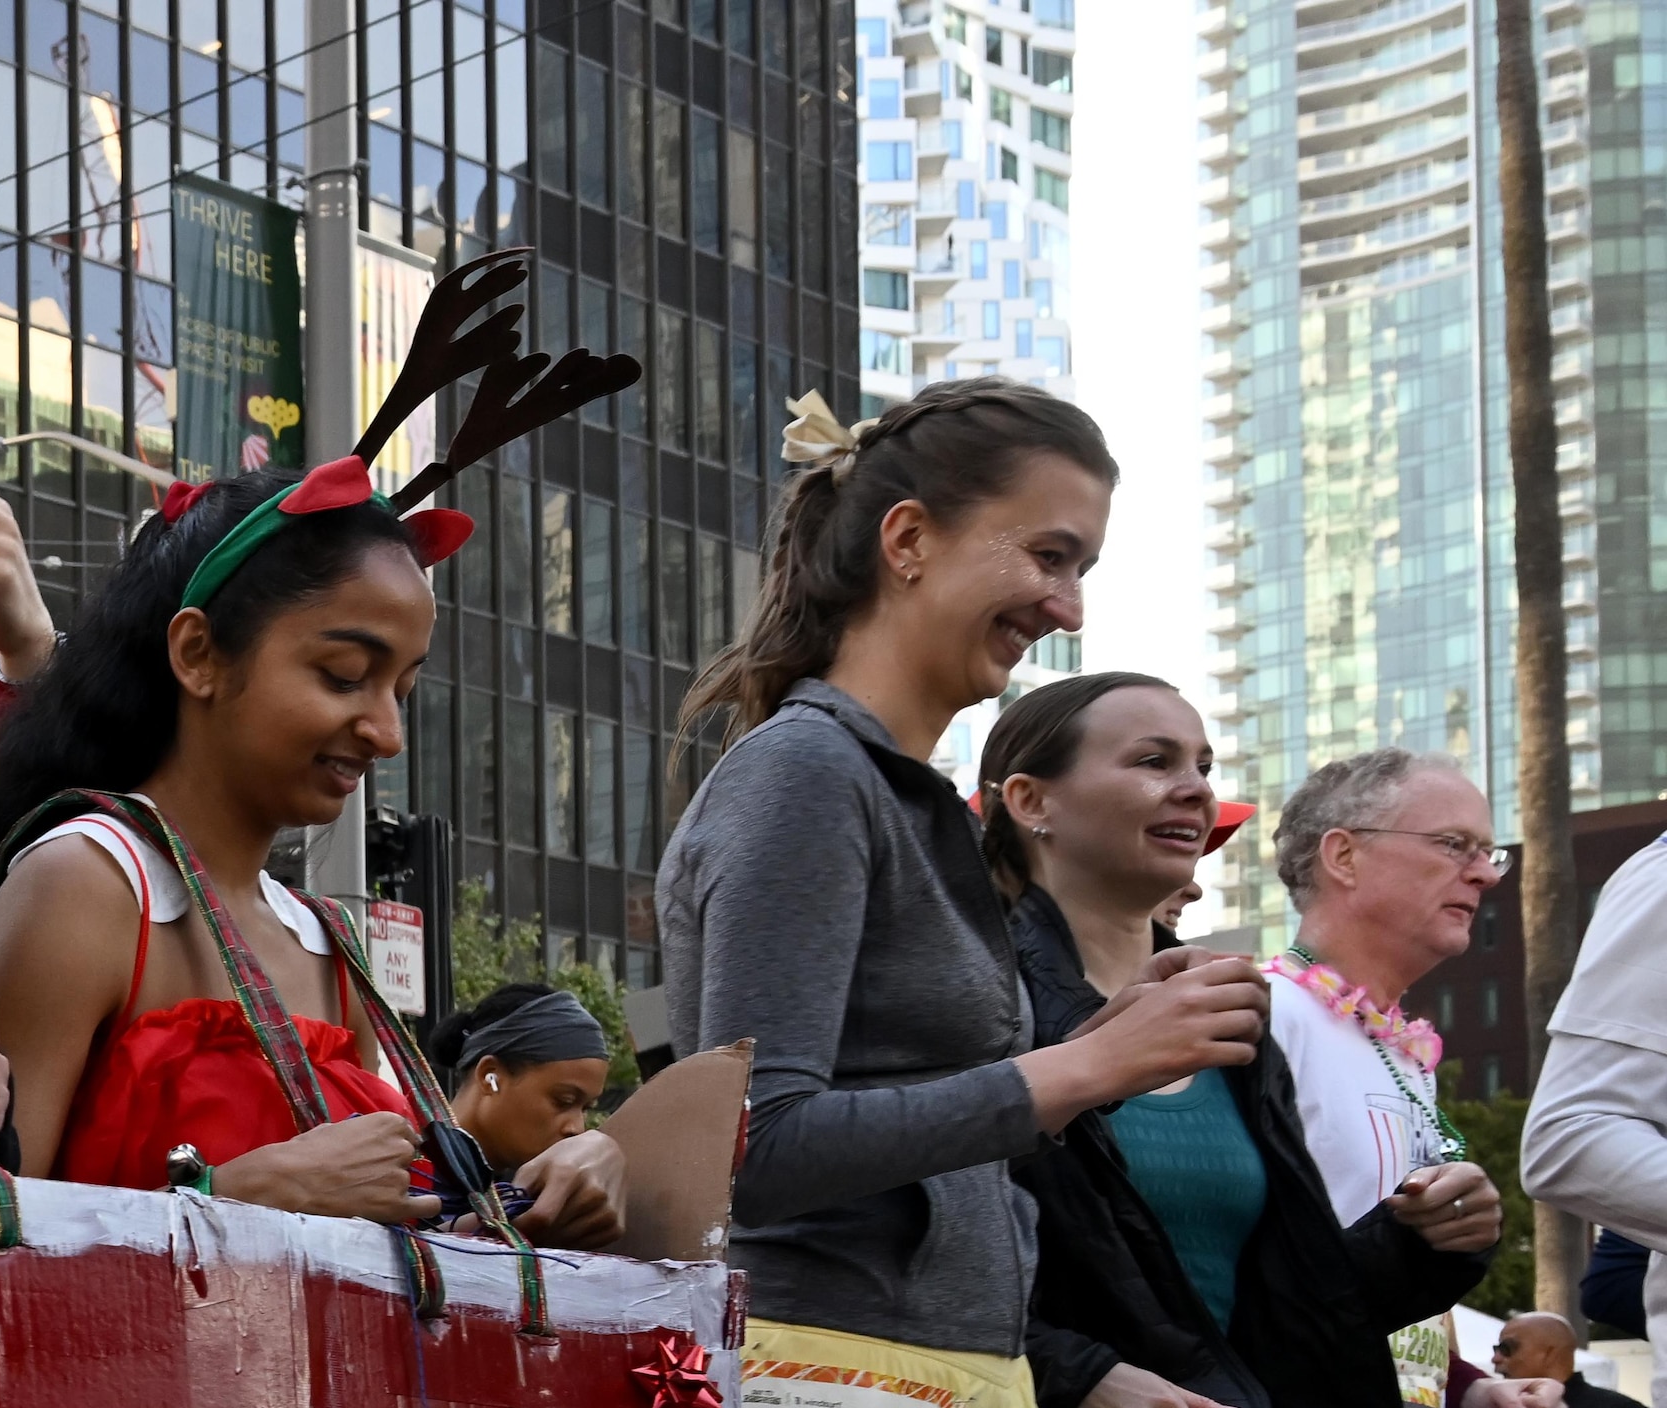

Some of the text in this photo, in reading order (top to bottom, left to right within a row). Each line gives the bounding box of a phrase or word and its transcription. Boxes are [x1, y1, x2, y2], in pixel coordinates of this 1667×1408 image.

[177, 188, 254, 242] THRIVE
[215, 240, 273, 285] HERE
[238, 332, 281, 359] PUBLIC
[233, 354, 264, 376] VISIT
[179, 457, 212, 484] THE
[371, 916, 387, 939] NO
[386, 951, 409, 969] ANY
[385, 969, 412, 989] TIME
